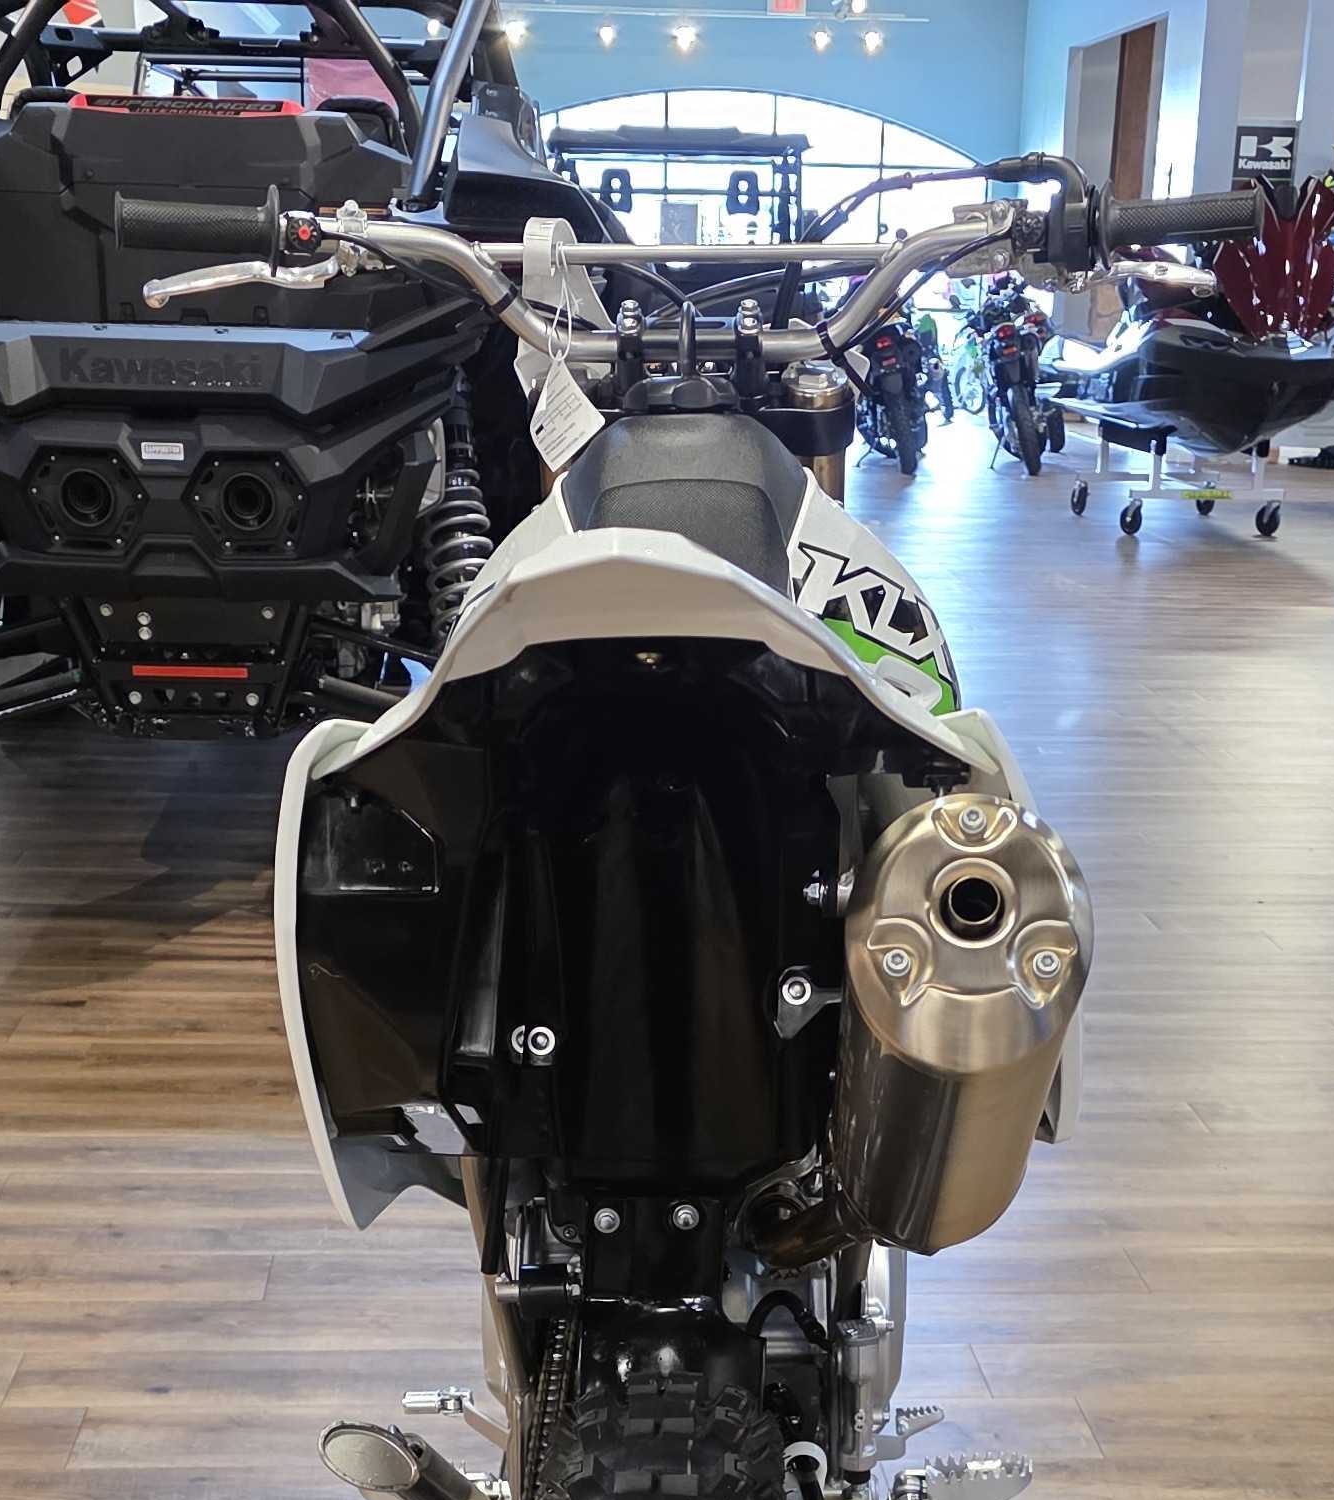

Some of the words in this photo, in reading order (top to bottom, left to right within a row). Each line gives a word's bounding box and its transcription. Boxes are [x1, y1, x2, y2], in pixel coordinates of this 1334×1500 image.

[94, 97, 277, 112] SUPERCHARGED
[1238, 158, 1291, 170] Kawasaki
[59, 347, 261, 386] Kawasaki
